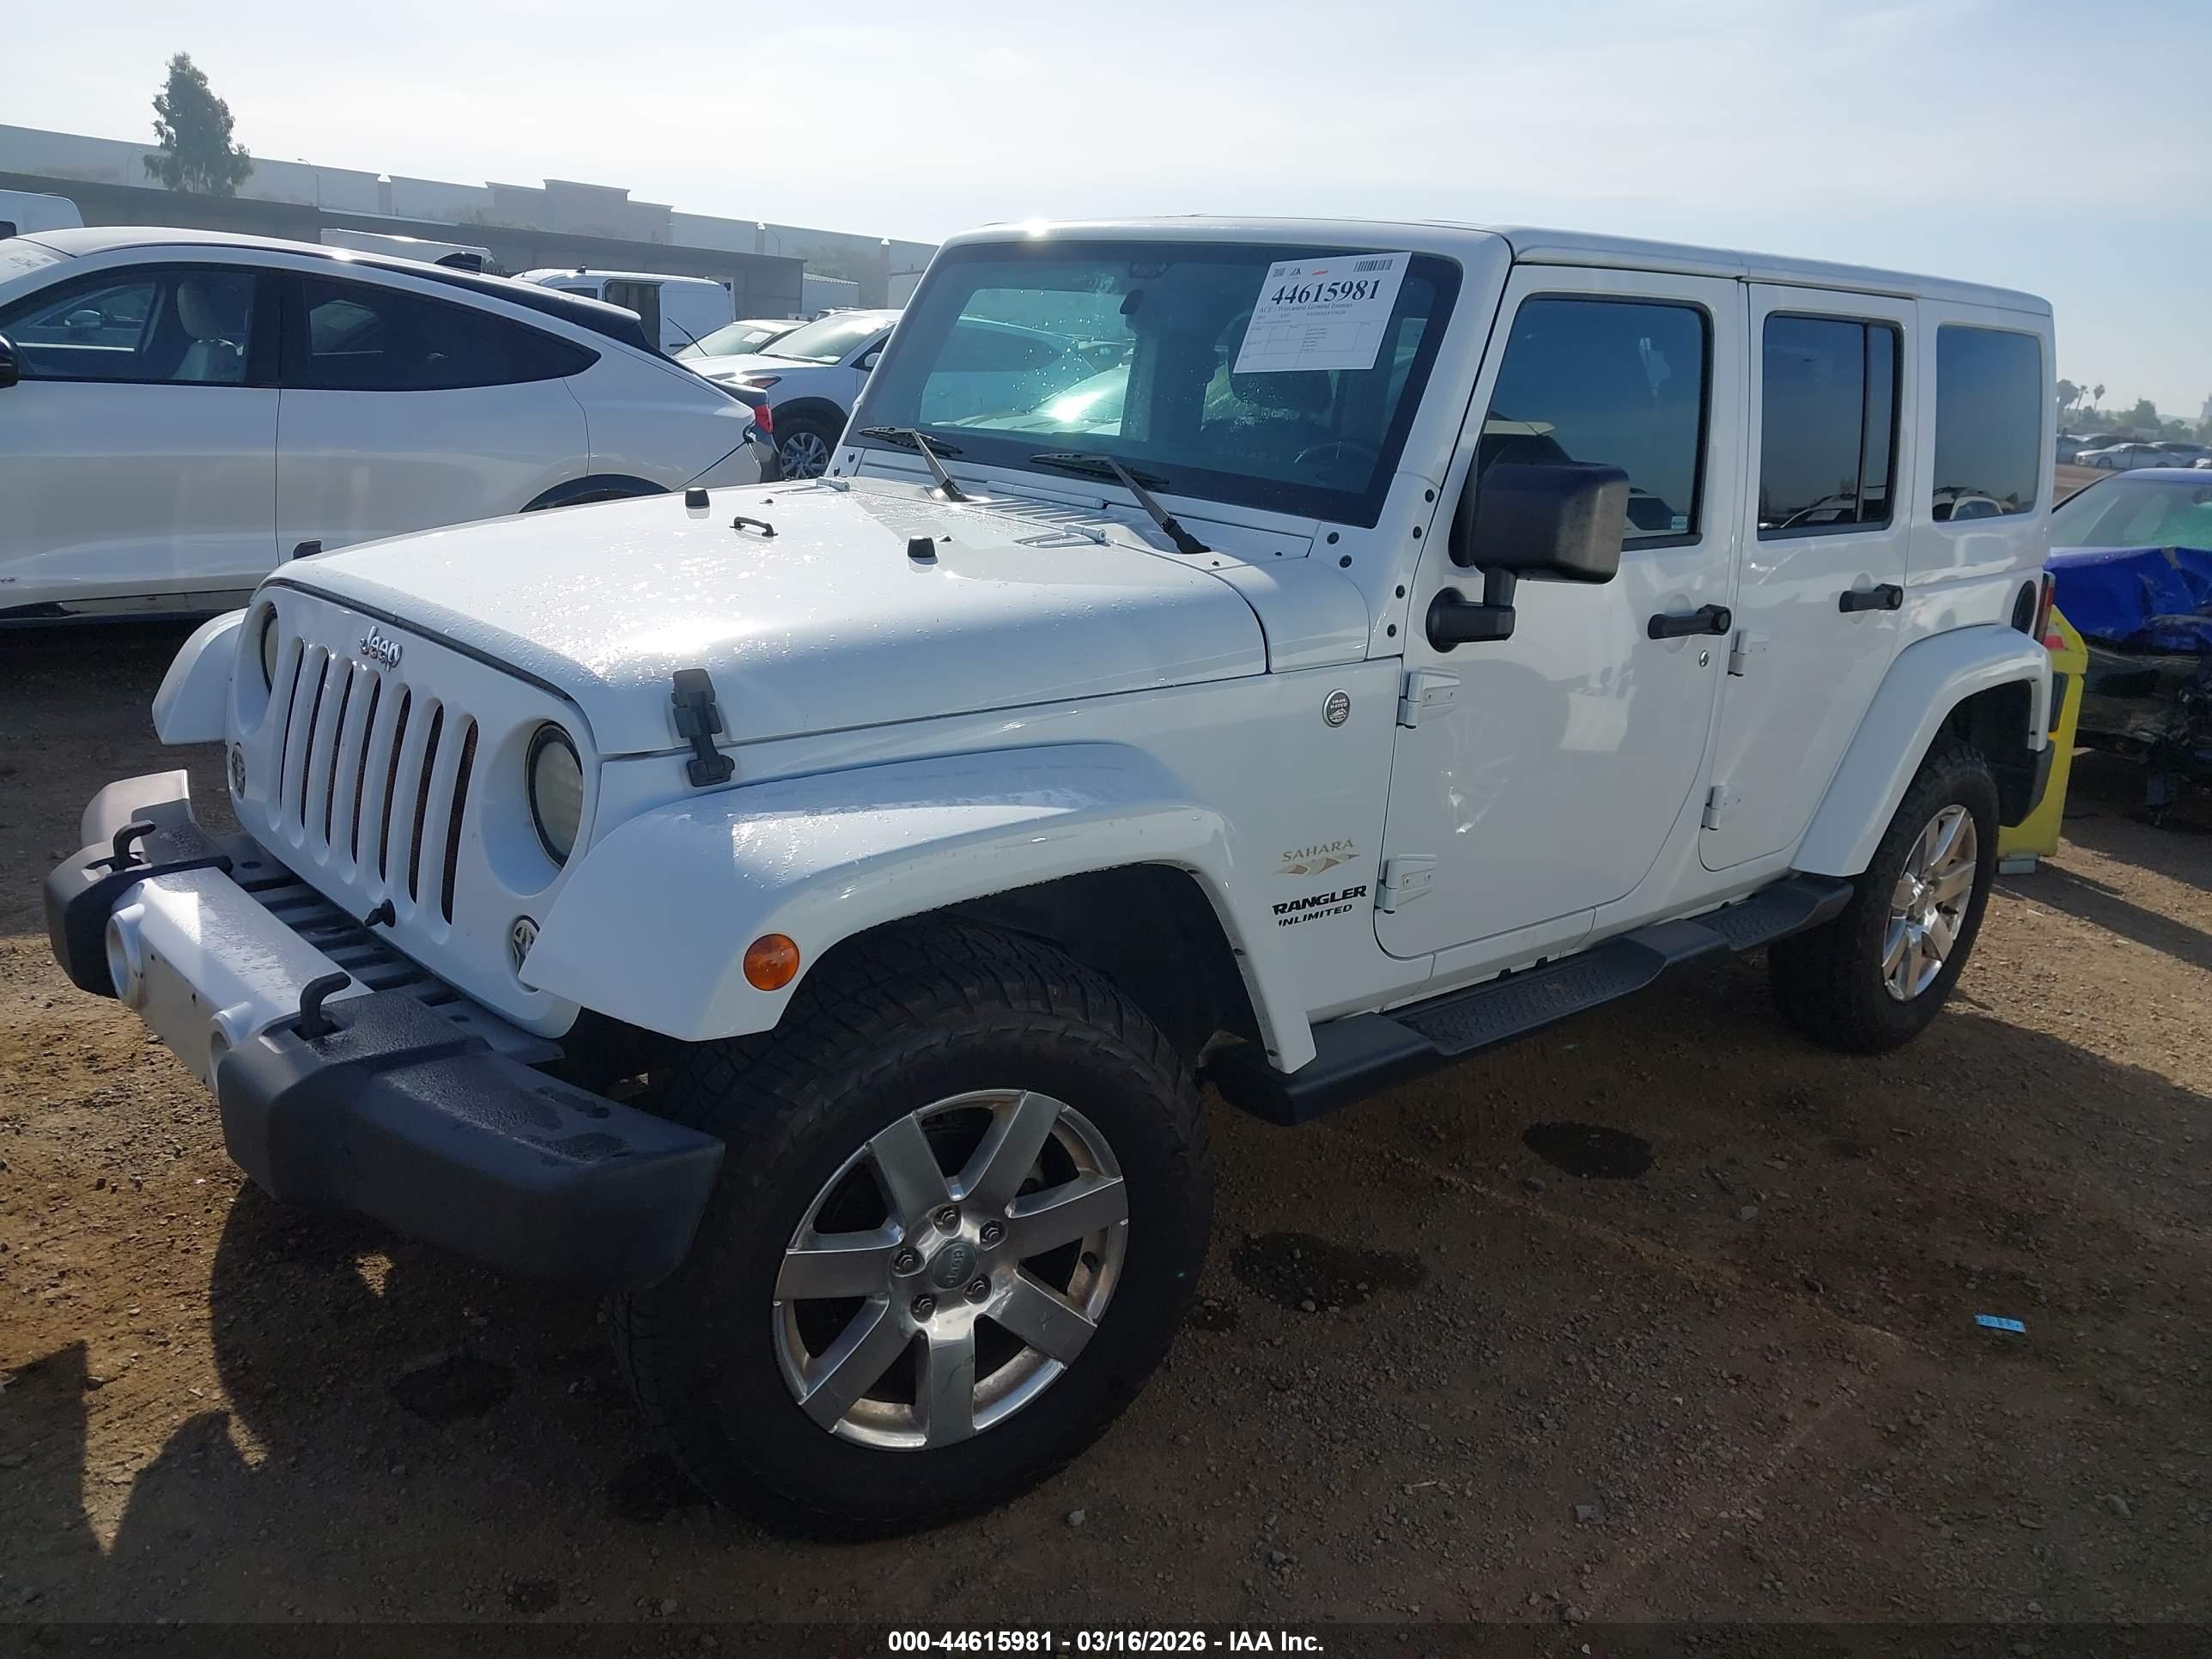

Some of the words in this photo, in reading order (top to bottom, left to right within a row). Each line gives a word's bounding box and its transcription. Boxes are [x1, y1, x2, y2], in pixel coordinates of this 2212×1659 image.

[1271, 279, 1382, 305] 44615981
[359, 625, 402, 672] Jeep
[1282, 838, 1354, 862] SAHARA
[946, 1249, 965, 1285] Jeep
